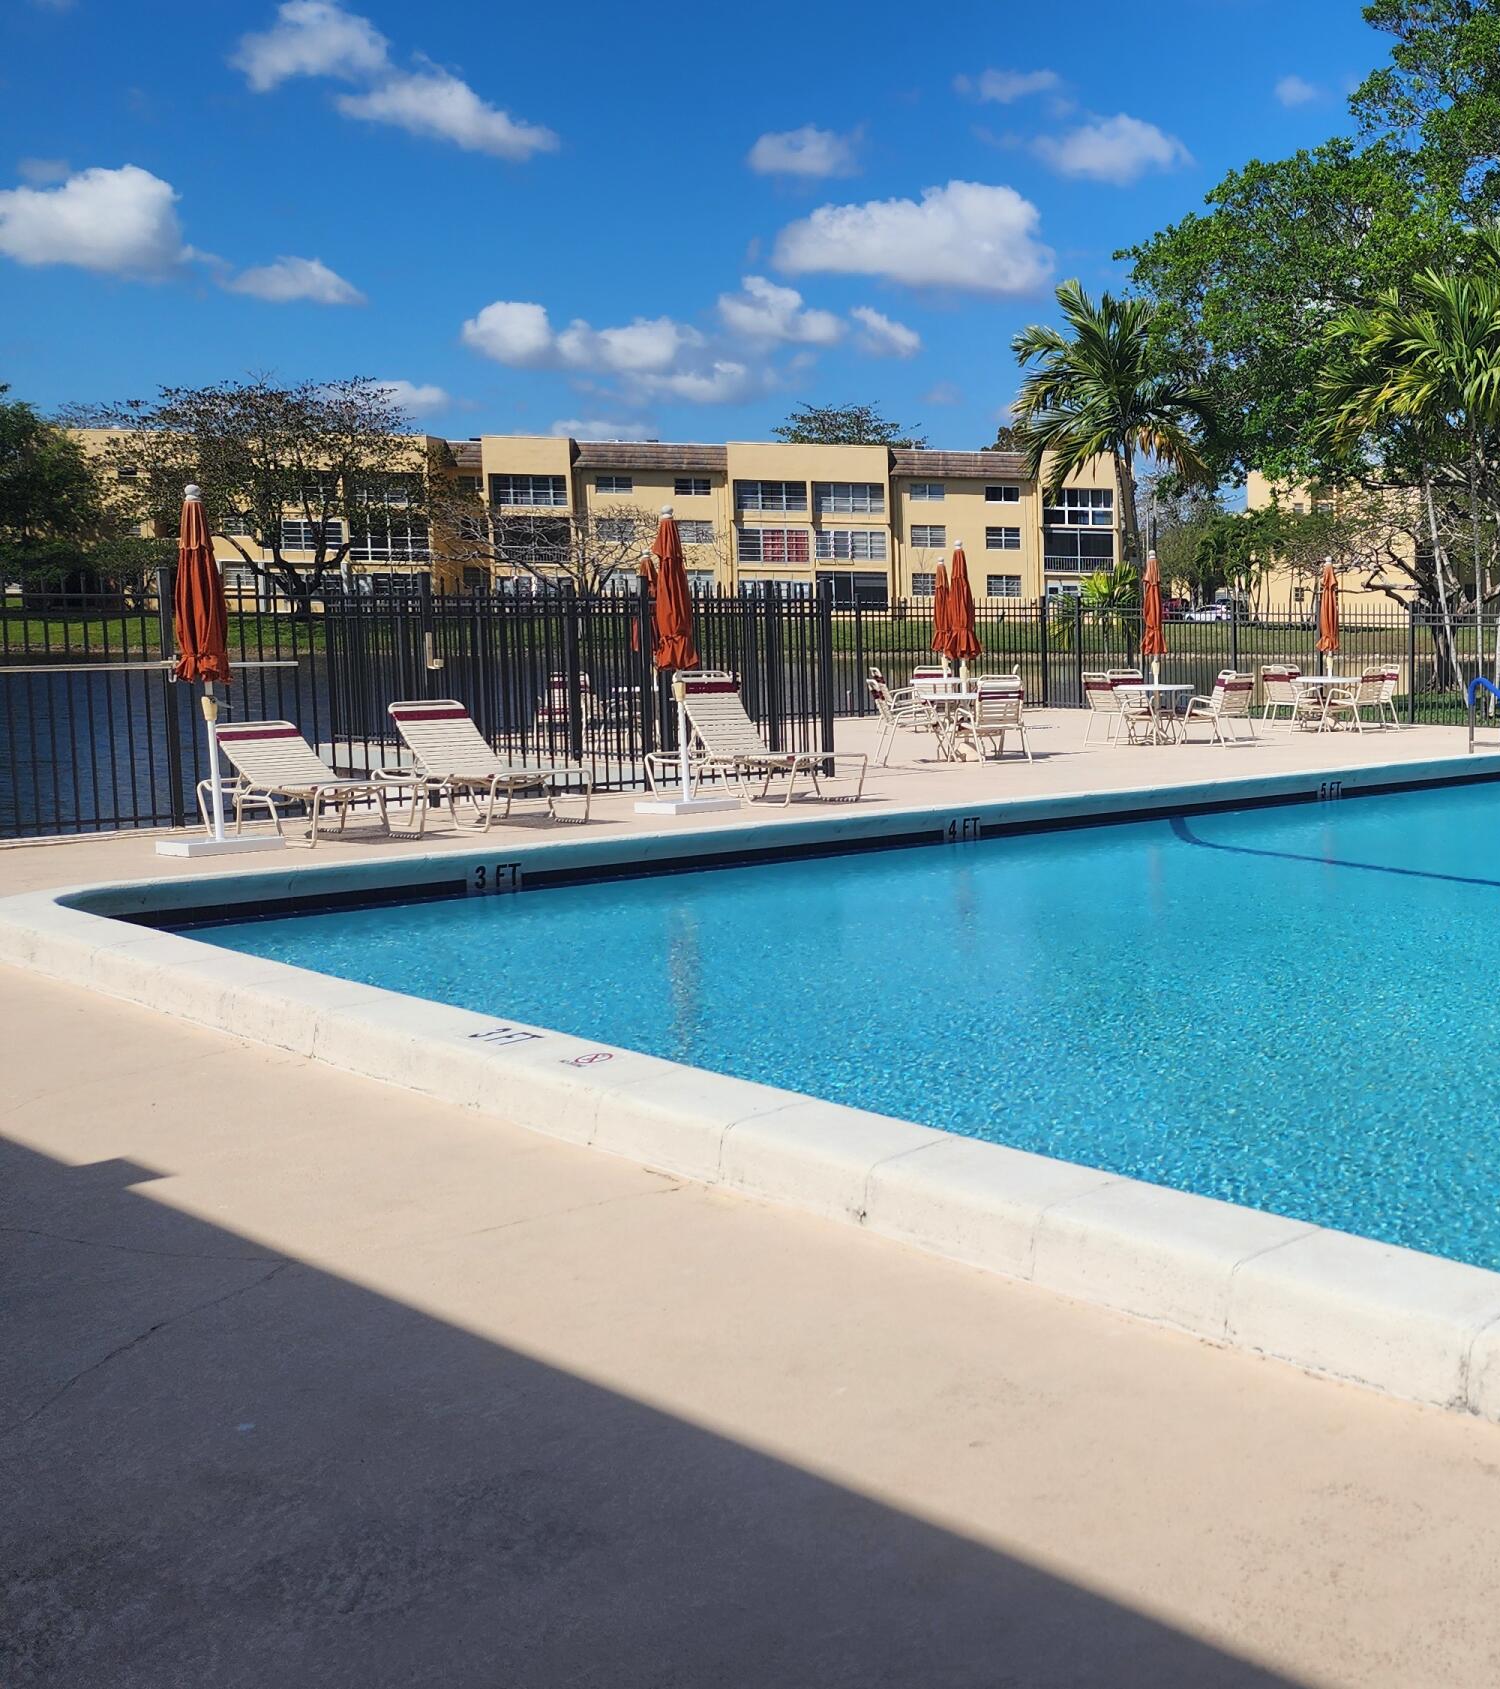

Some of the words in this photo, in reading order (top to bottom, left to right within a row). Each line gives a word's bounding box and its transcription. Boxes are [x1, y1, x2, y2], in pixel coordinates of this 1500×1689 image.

[1321, 782, 1328, 799] 5
[1329, 781, 1343, 799] FT
[948, 819, 957, 839] 4
[962, 817, 980, 837] FT
[474, 865, 486, 889] 3
[496, 862, 521, 887] FT
[468, 1027, 512, 1038] 3
[484, 1031, 545, 1046] FT
